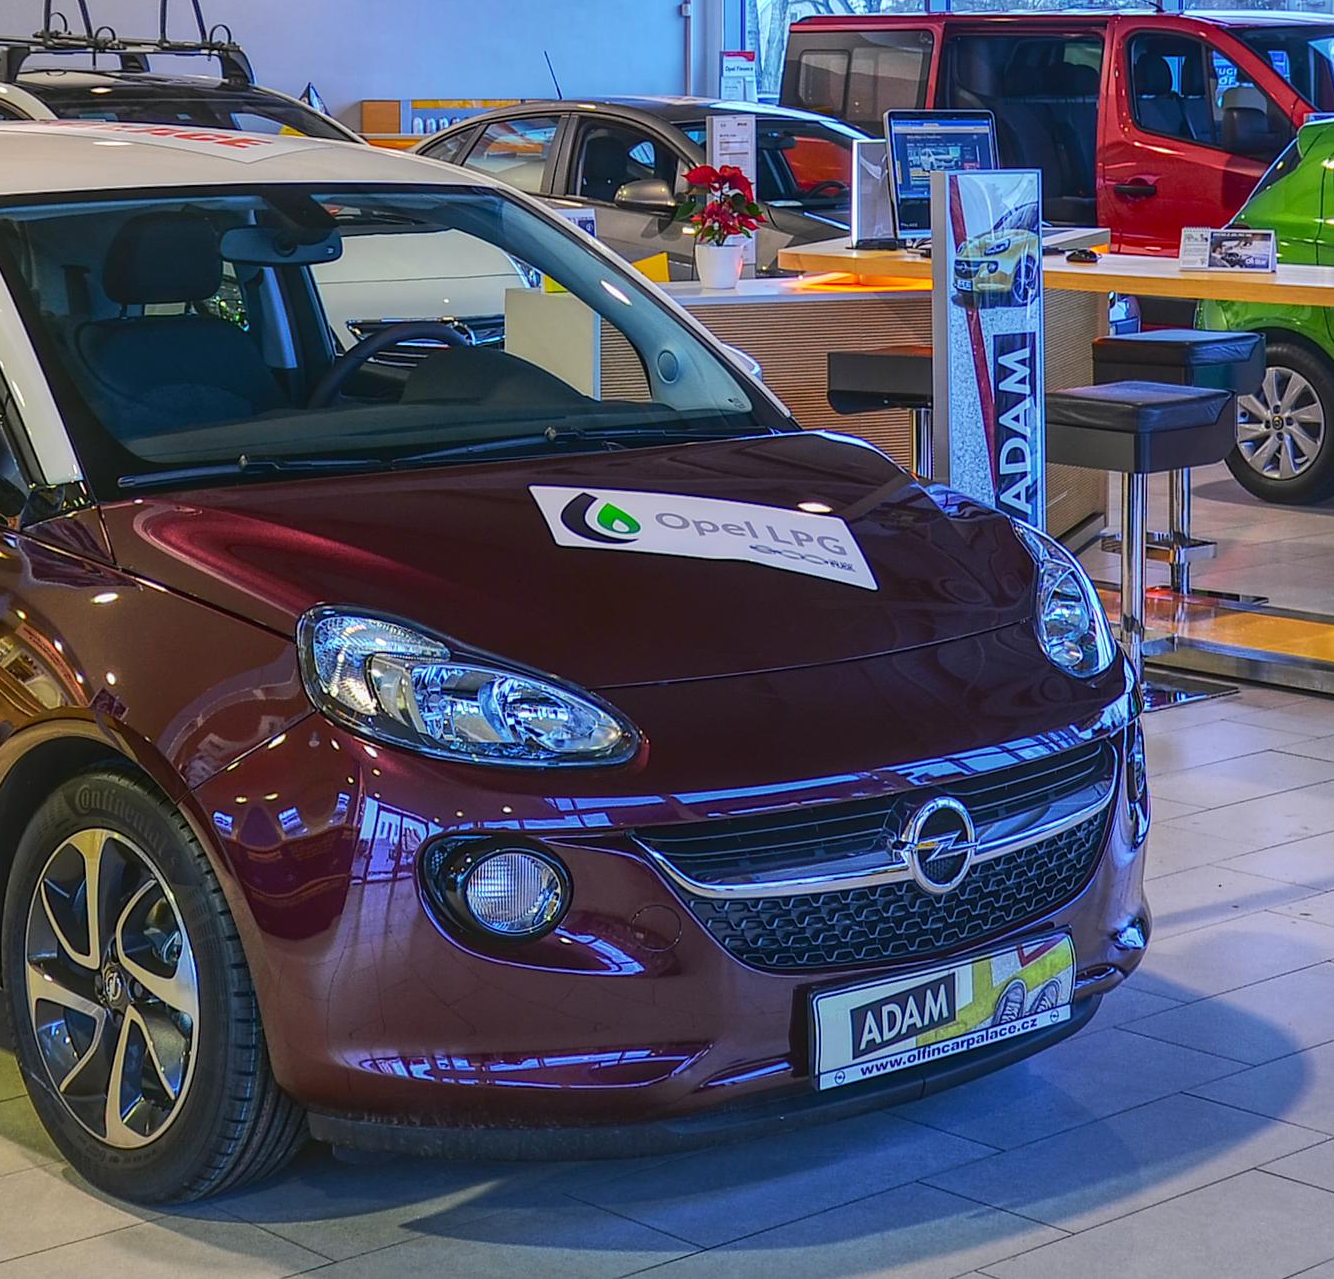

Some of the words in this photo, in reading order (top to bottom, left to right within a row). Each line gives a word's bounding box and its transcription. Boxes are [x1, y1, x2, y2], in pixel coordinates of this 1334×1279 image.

[998, 347, 1034, 514] ADAM
[655, 512, 759, 539] Opel
[766, 525, 848, 556] LPG
[74, 784, 163, 857] Continental
[859, 983, 949, 1050] ADAM
[861, 1017, 1038, 1076] www.olfincarpalace.cz
